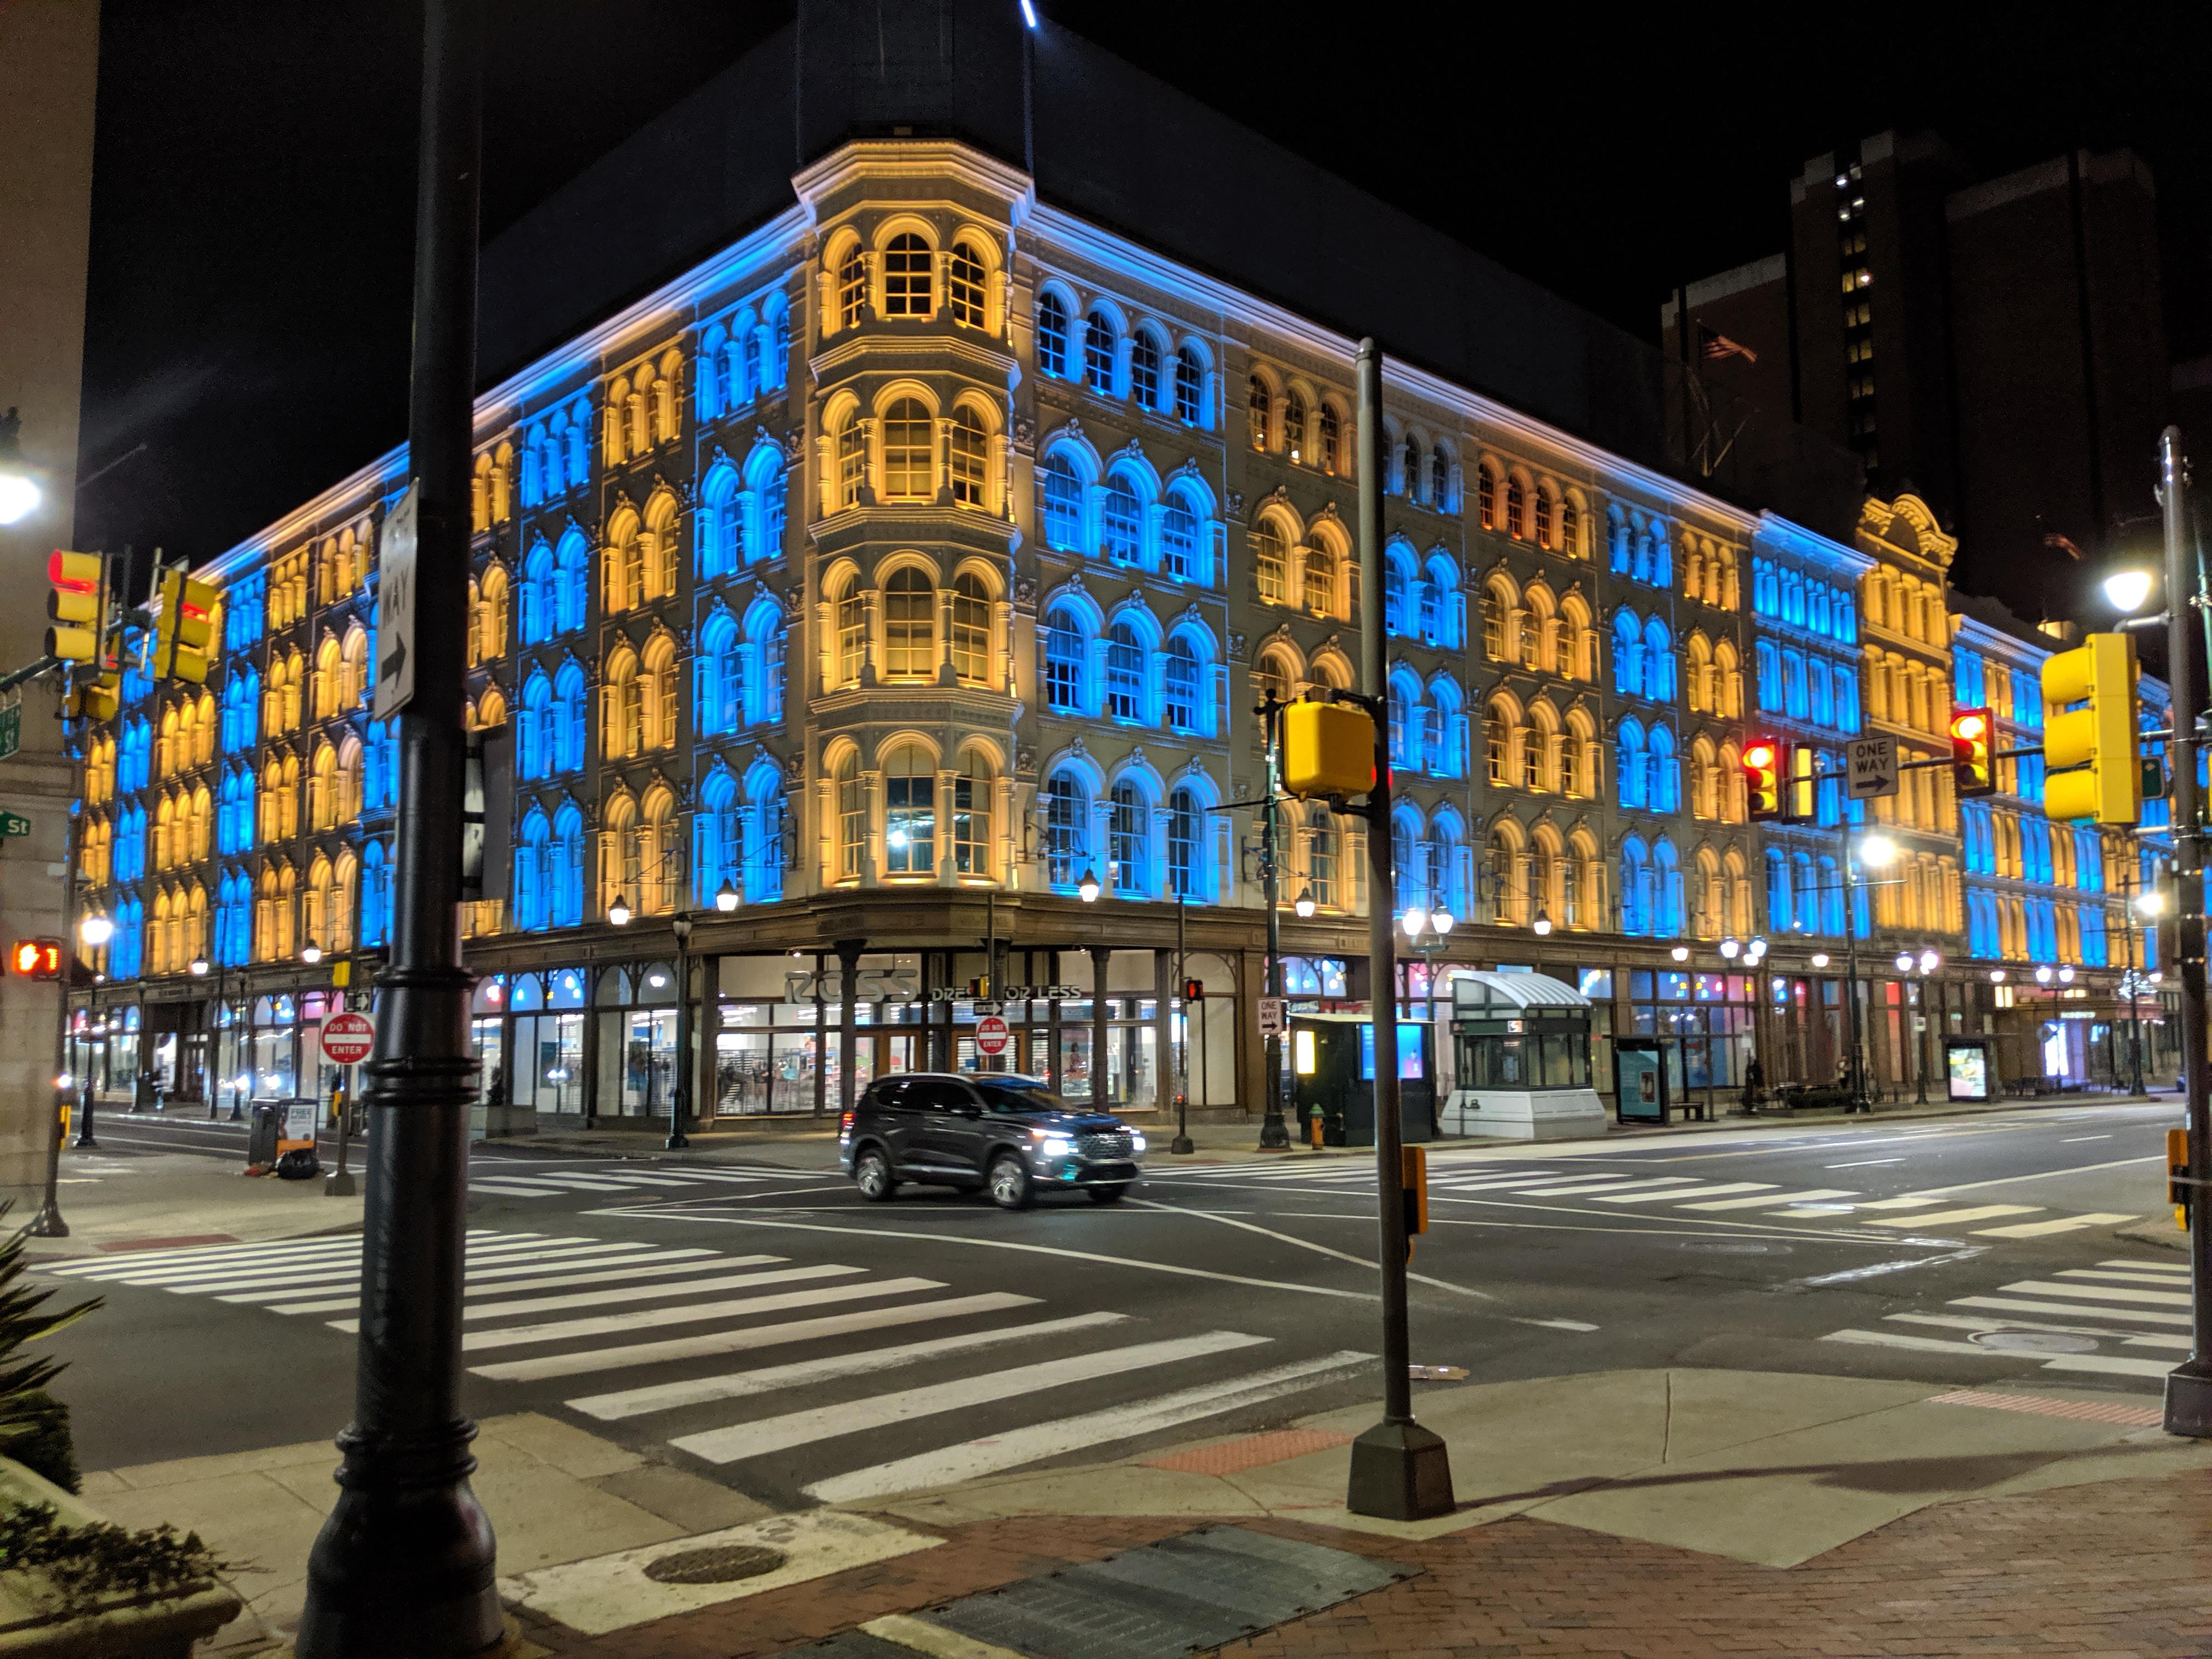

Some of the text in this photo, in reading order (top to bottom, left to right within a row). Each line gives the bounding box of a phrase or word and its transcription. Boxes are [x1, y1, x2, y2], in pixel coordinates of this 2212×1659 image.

[1856, 741, 1887, 757] ONE
[1855, 758, 1888, 773] WAY
[8, 819, 27, 834] St
[785, 970, 918, 1004] ROSS
[933, 986, 1081, 1001] DRE OR LESS
[1262, 1001, 1277, 1010] ONE
[1262, 1012, 1278, 1020] WAY
[330, 1023, 366, 1031] DO NOT
[331, 1046, 362, 1054] ENTER
